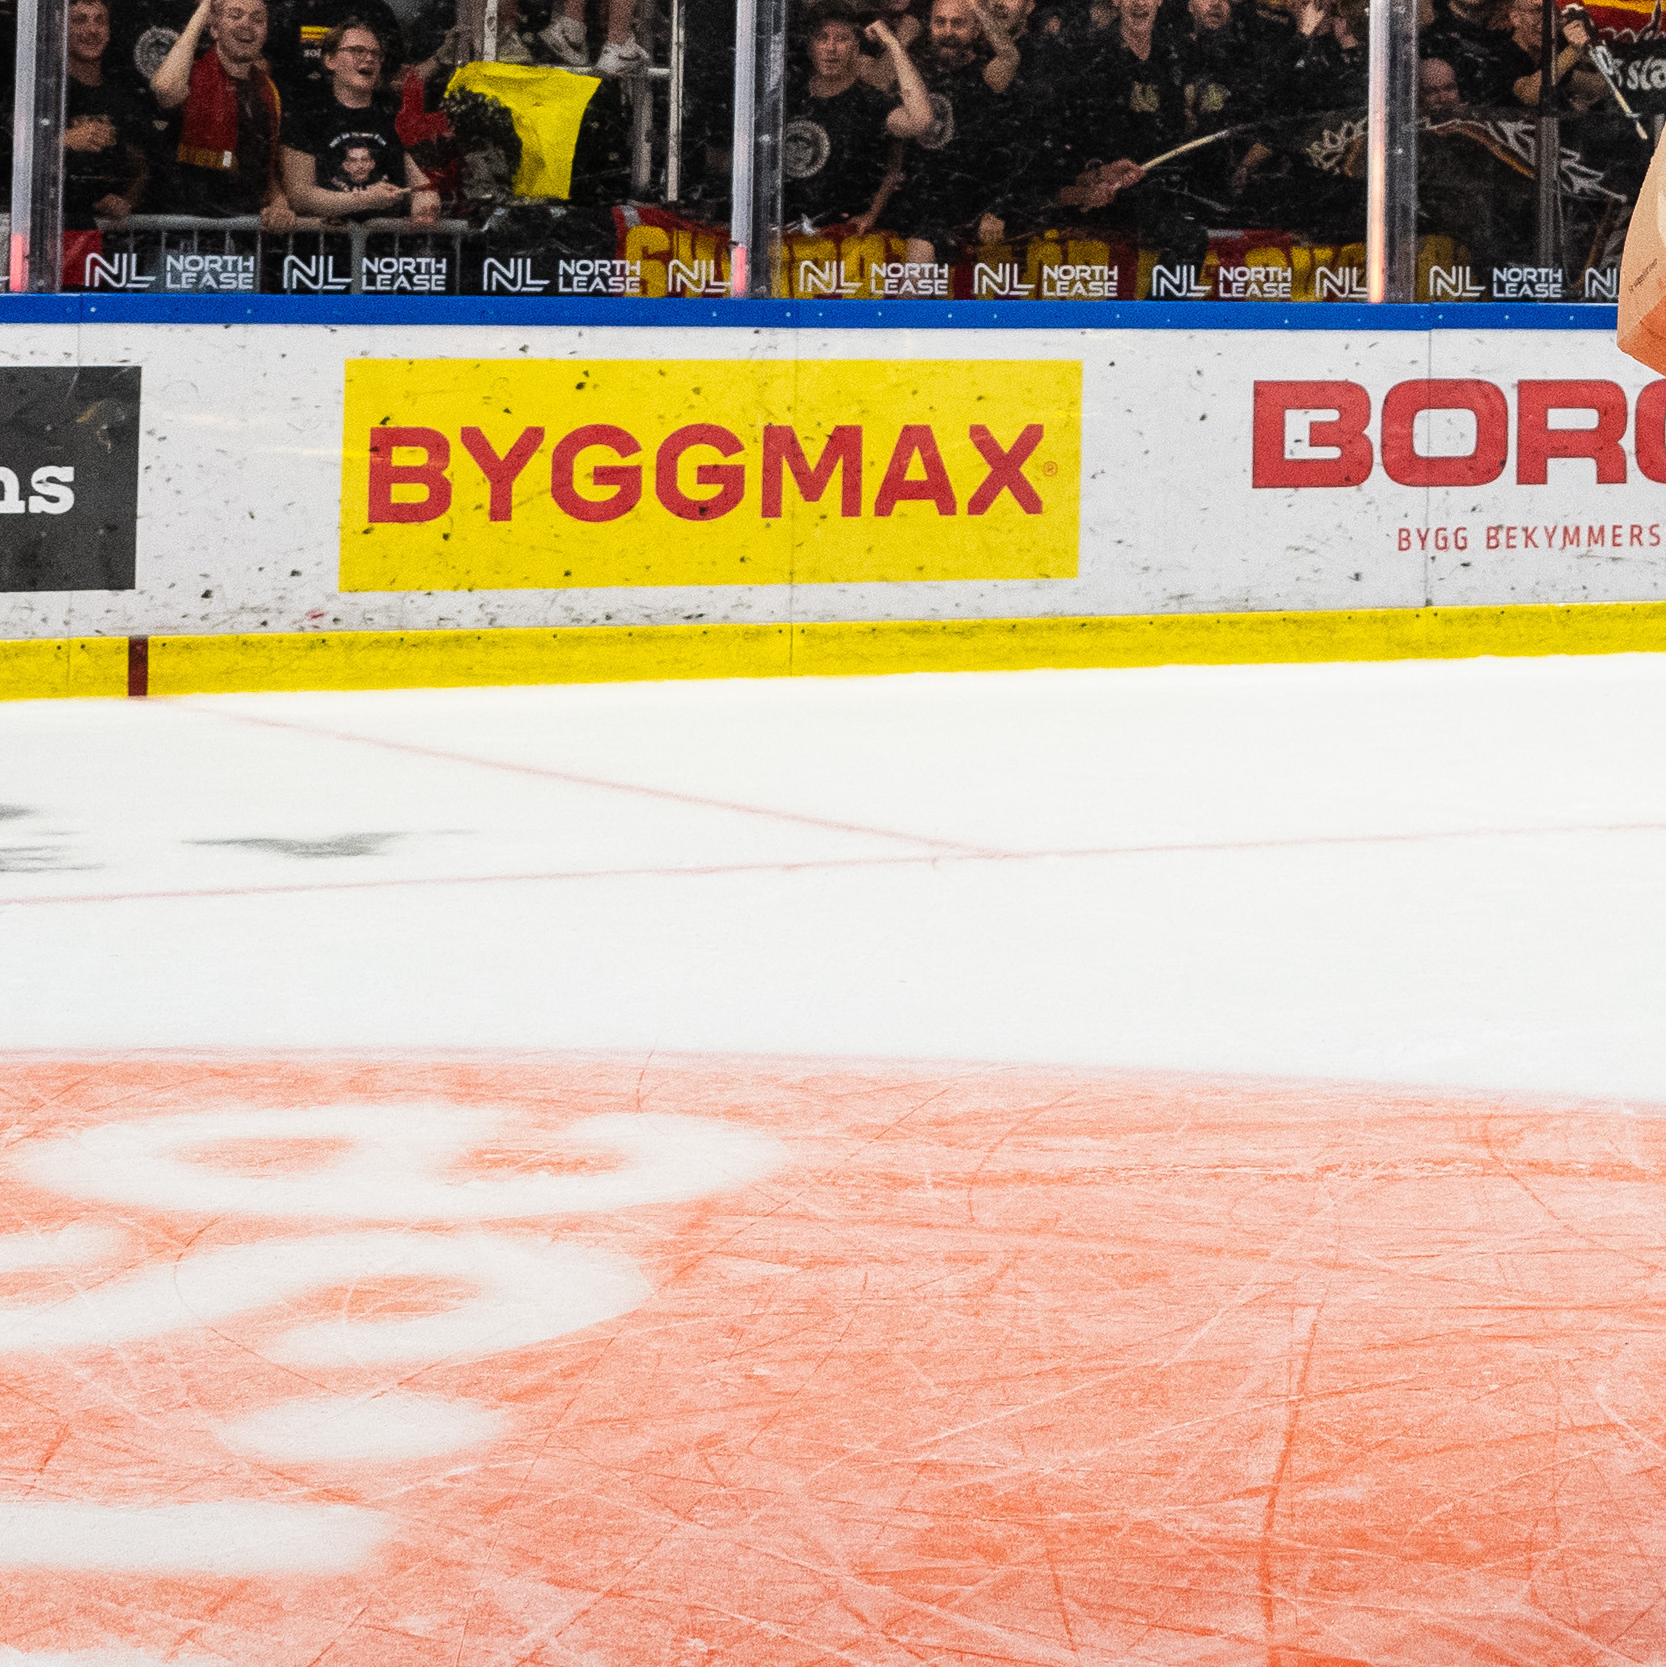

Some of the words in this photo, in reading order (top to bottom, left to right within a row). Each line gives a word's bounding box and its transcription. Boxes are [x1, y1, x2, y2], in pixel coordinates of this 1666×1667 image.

[166, 255, 254, 271] NORTH
[362, 258, 446, 273] NORTH
[559, 259, 640, 275] NORTH
[871, 263, 948, 278] NORTH
[167, 272, 254, 288] LEASE
[1043, 265, 1118, 280] NORTH
[1220, 266, 1292, 281] NORTH
[1493, 267, 1562, 282] NORTH
[362, 274, 446, 291] LEASE
[559, 276, 640, 292] LEASE
[871, 279, 948, 294] LEASE
[1043, 281, 1118, 296] LEASE
[1220, 282, 1292, 298] LEASE
[1493, 283, 1562, 298] LEASE
[368, 423, 1045, 523] BYGGMAX
[1398, 527, 1469, 552] BYGG
